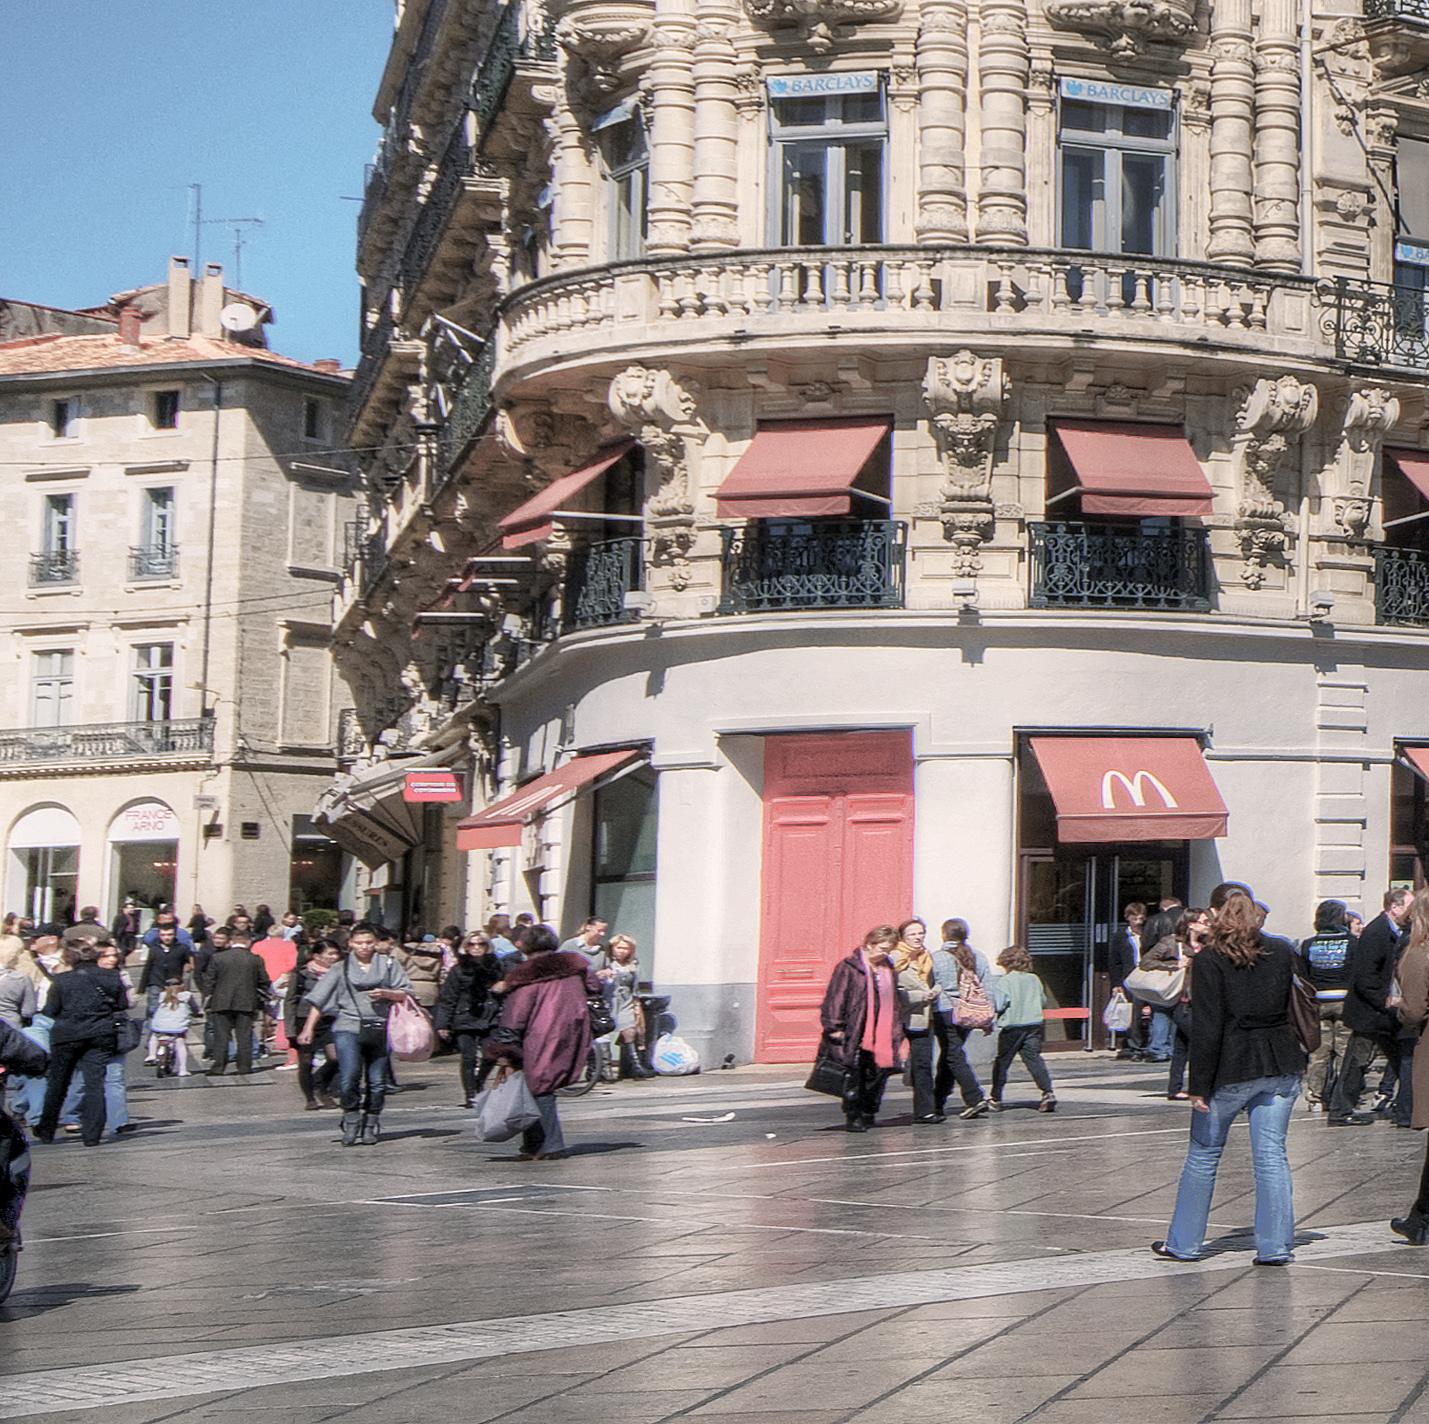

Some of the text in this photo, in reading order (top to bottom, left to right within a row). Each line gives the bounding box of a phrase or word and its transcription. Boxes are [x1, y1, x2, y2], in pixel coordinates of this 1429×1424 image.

[791, 74, 874, 93] BARCLAYS
[1087, 83, 1169, 105] BARCLAYS
[125, 808, 173, 820] FRANCE
